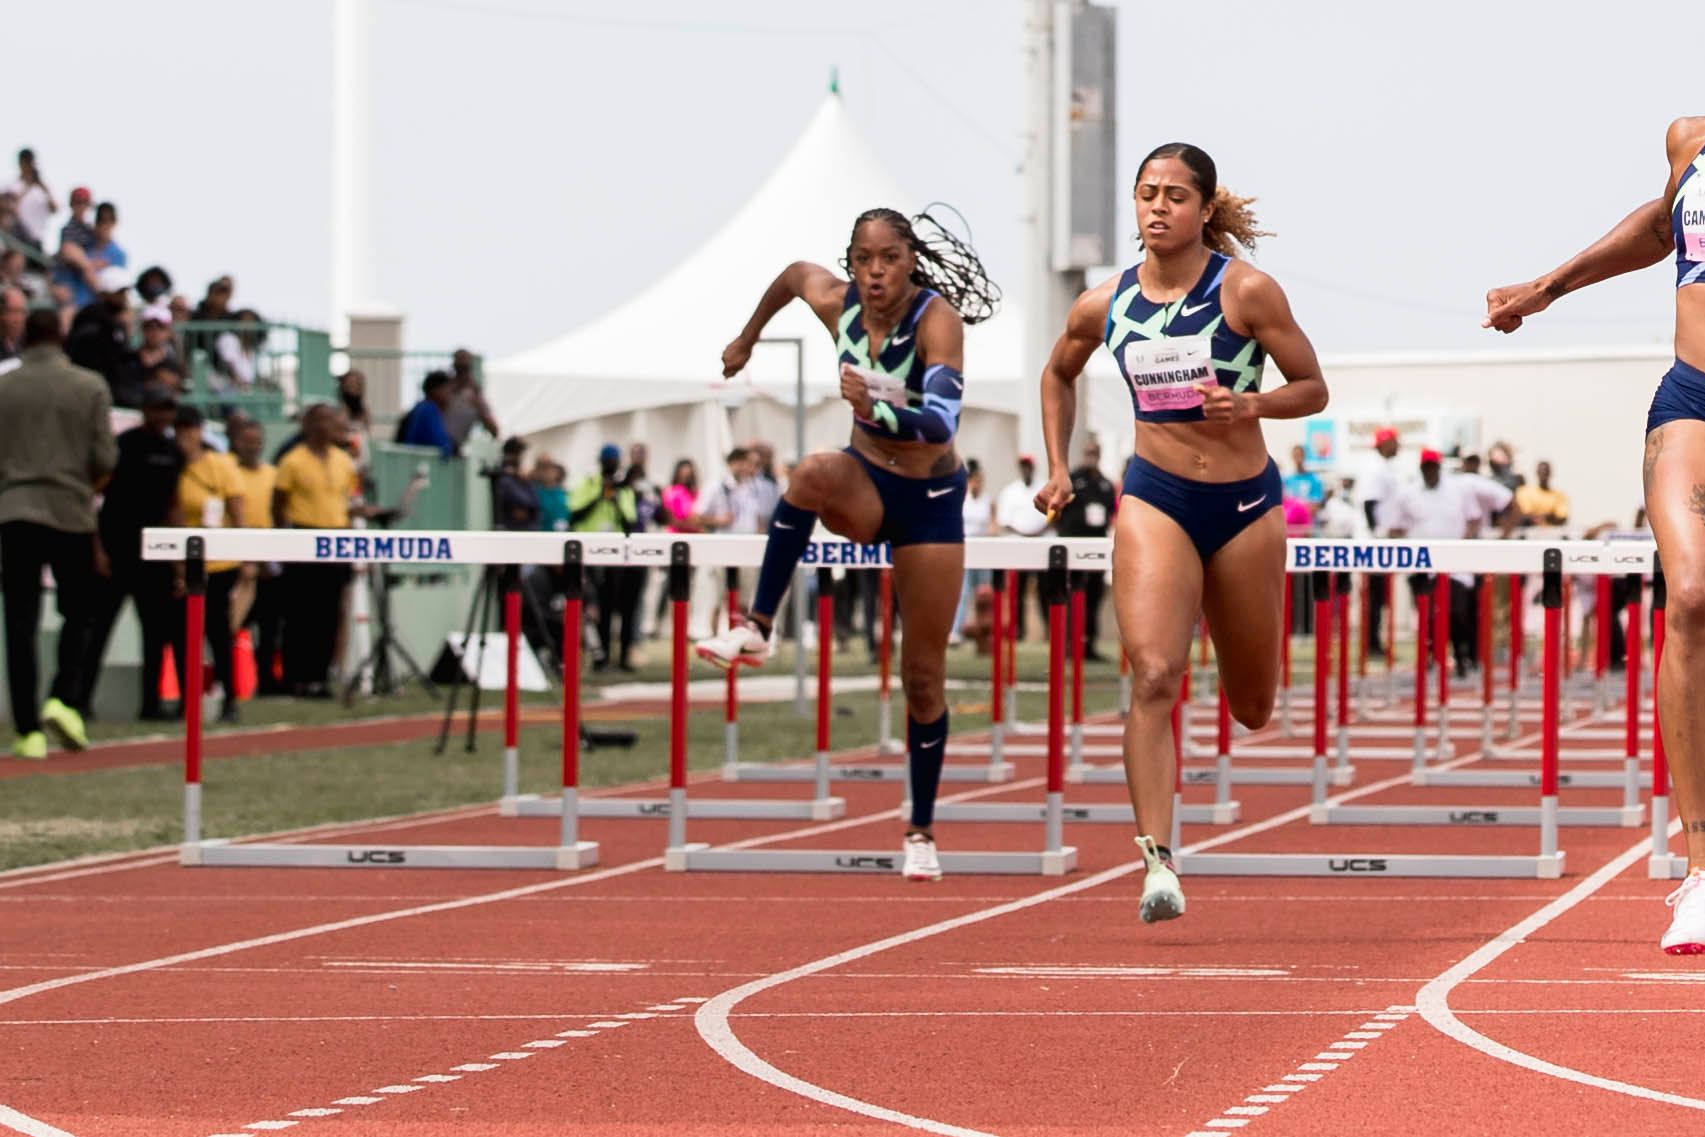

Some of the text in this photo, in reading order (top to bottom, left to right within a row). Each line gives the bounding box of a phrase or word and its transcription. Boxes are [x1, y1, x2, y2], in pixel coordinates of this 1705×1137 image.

[1133, 366, 1210, 386] CUNNINGHAM
[314, 536, 453, 560] BERMUDA
[1294, 545, 1433, 569] BERMUDA
[1569, 555, 1600, 563] UCS
[1529, 775, 1572, 785] US
[640, 803, 671, 814] UC
[1449, 812, 1498, 822] UCS
[347, 851, 406, 863] UCS
[836, 856, 894, 869] UCS
[1329, 859, 1387, 871] UCS
